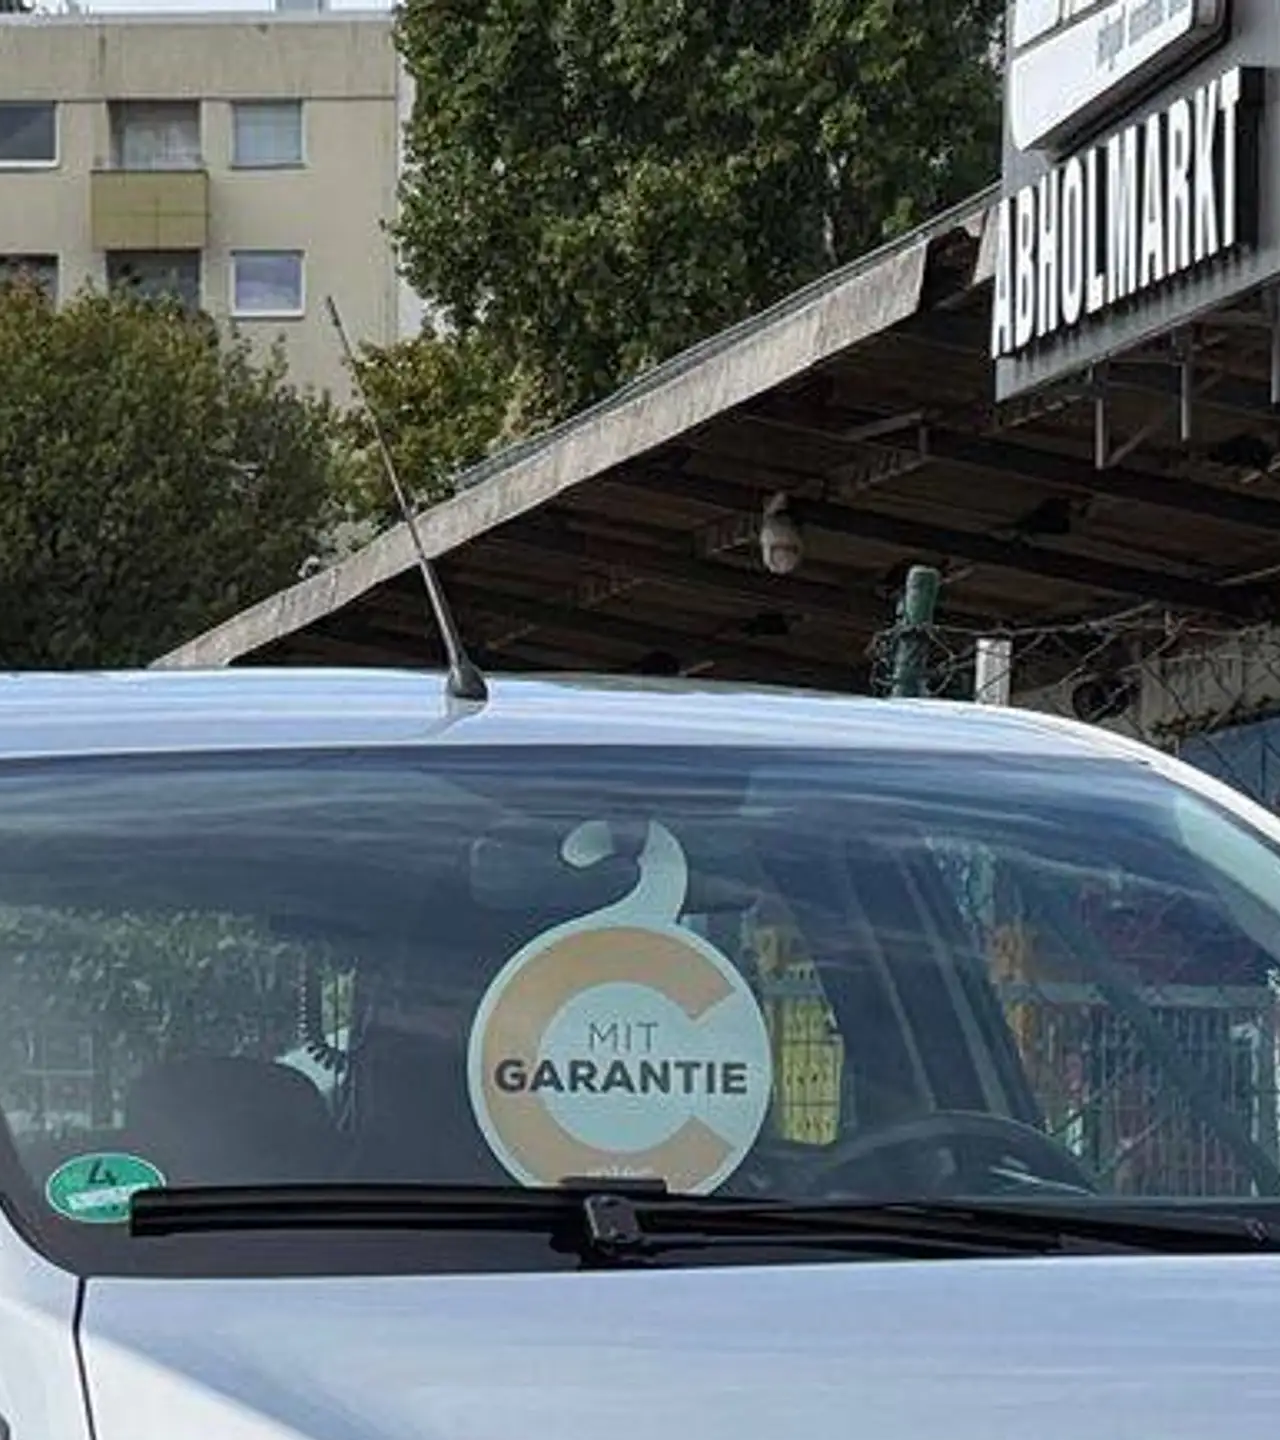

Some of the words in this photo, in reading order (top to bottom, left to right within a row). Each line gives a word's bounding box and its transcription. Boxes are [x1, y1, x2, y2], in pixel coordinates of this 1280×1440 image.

[991, 65, 1240, 360] ABHOLMARKT
[588, 1021, 660, 1052] MIT
[494, 1058, 749, 1095] GARANTIE
[88, 1156, 118, 1186] 4
